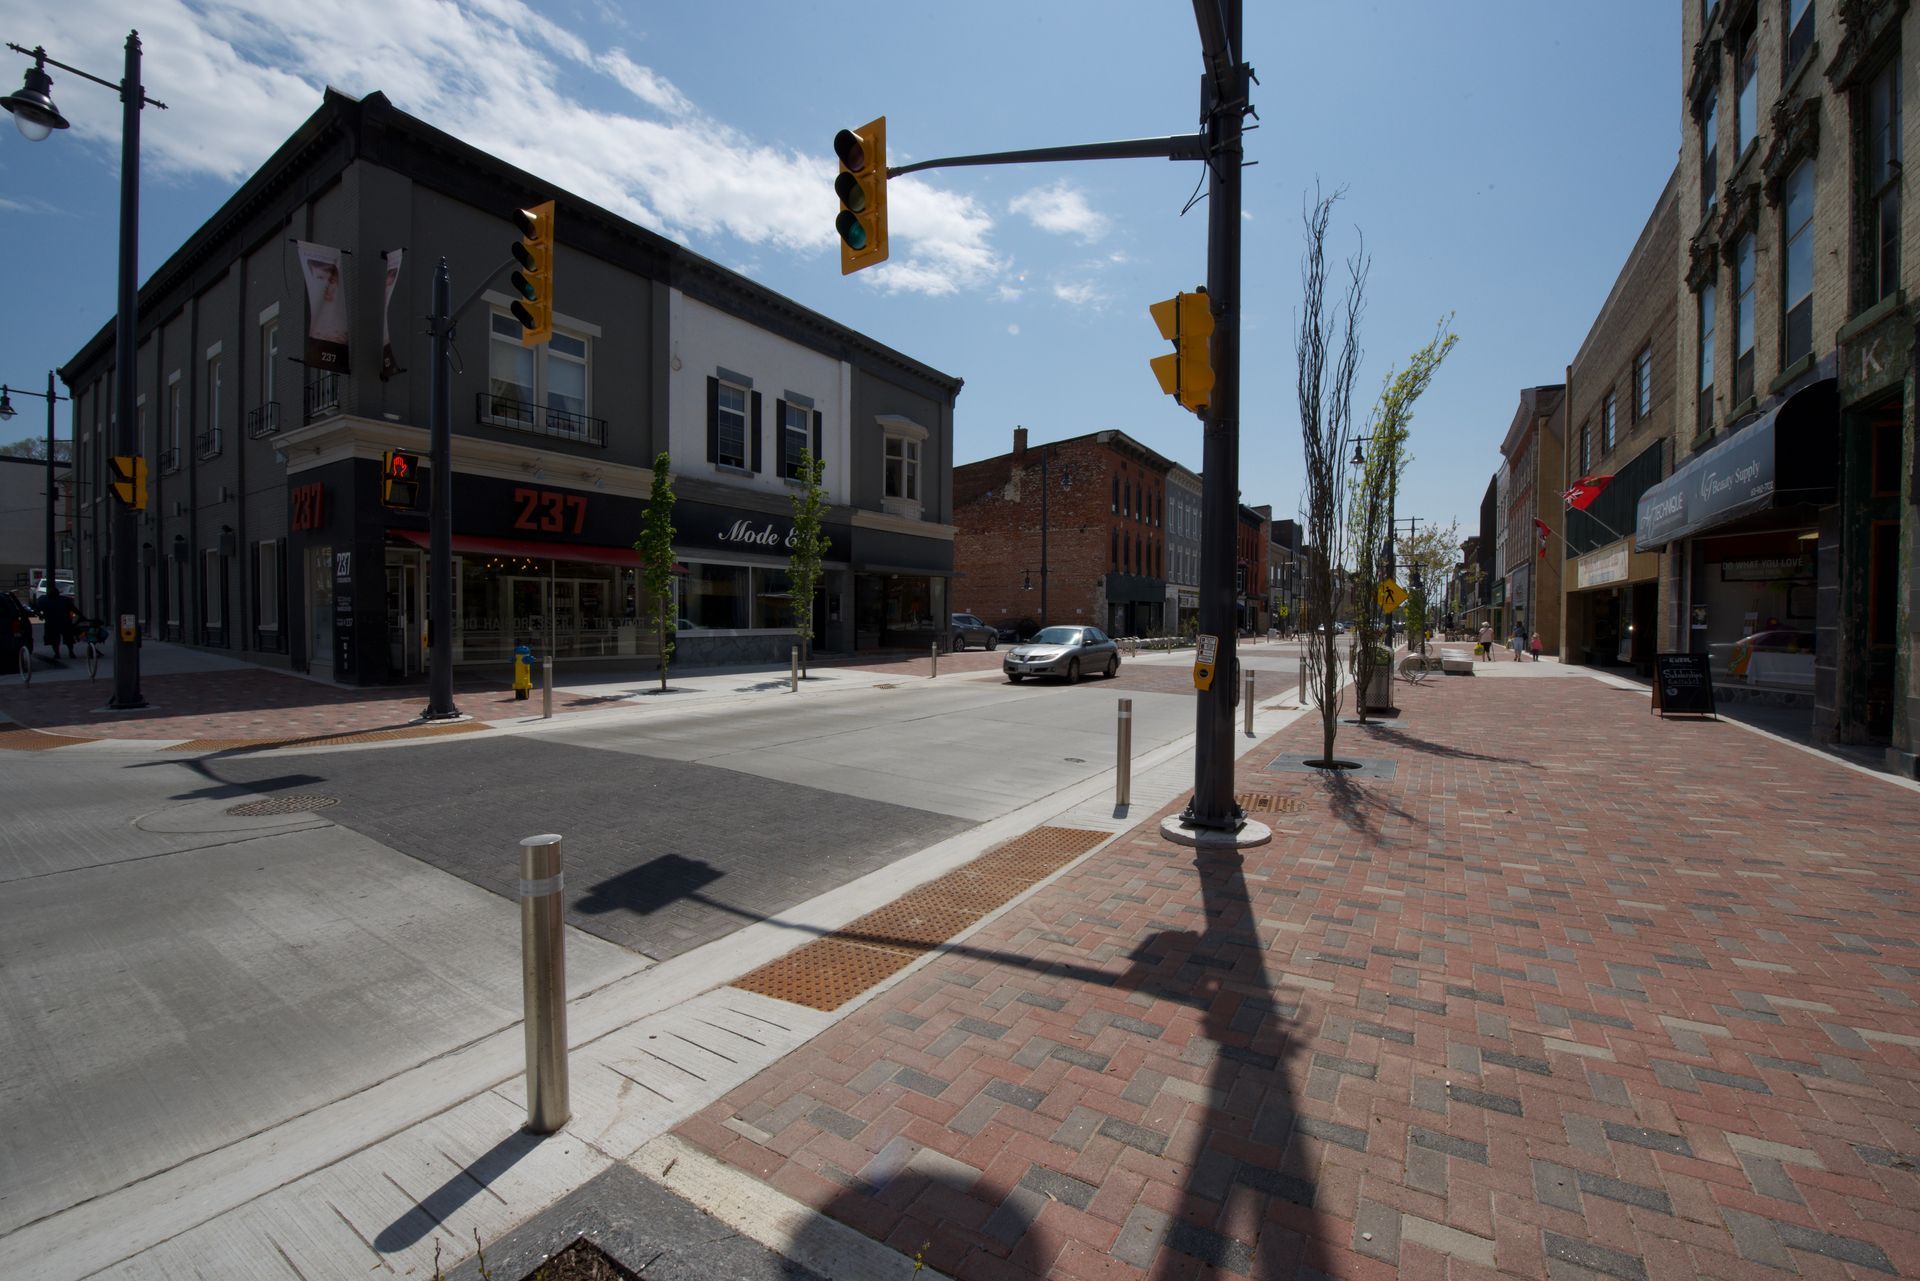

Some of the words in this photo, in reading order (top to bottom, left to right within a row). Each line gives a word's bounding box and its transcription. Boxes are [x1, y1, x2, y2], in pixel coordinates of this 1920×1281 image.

[321, 351, 337, 362] 237
[1862, 337, 1883, 381] K
[1713, 475, 1733, 495] Beauty
[1735, 459, 1761, 483] Supply
[291, 481, 322, 532] 237
[513, 488, 588, 536] 237
[718, 519, 780, 546] Mode
[336, 551, 351, 576] 237
[1781, 558, 1804, 568] LOVE
